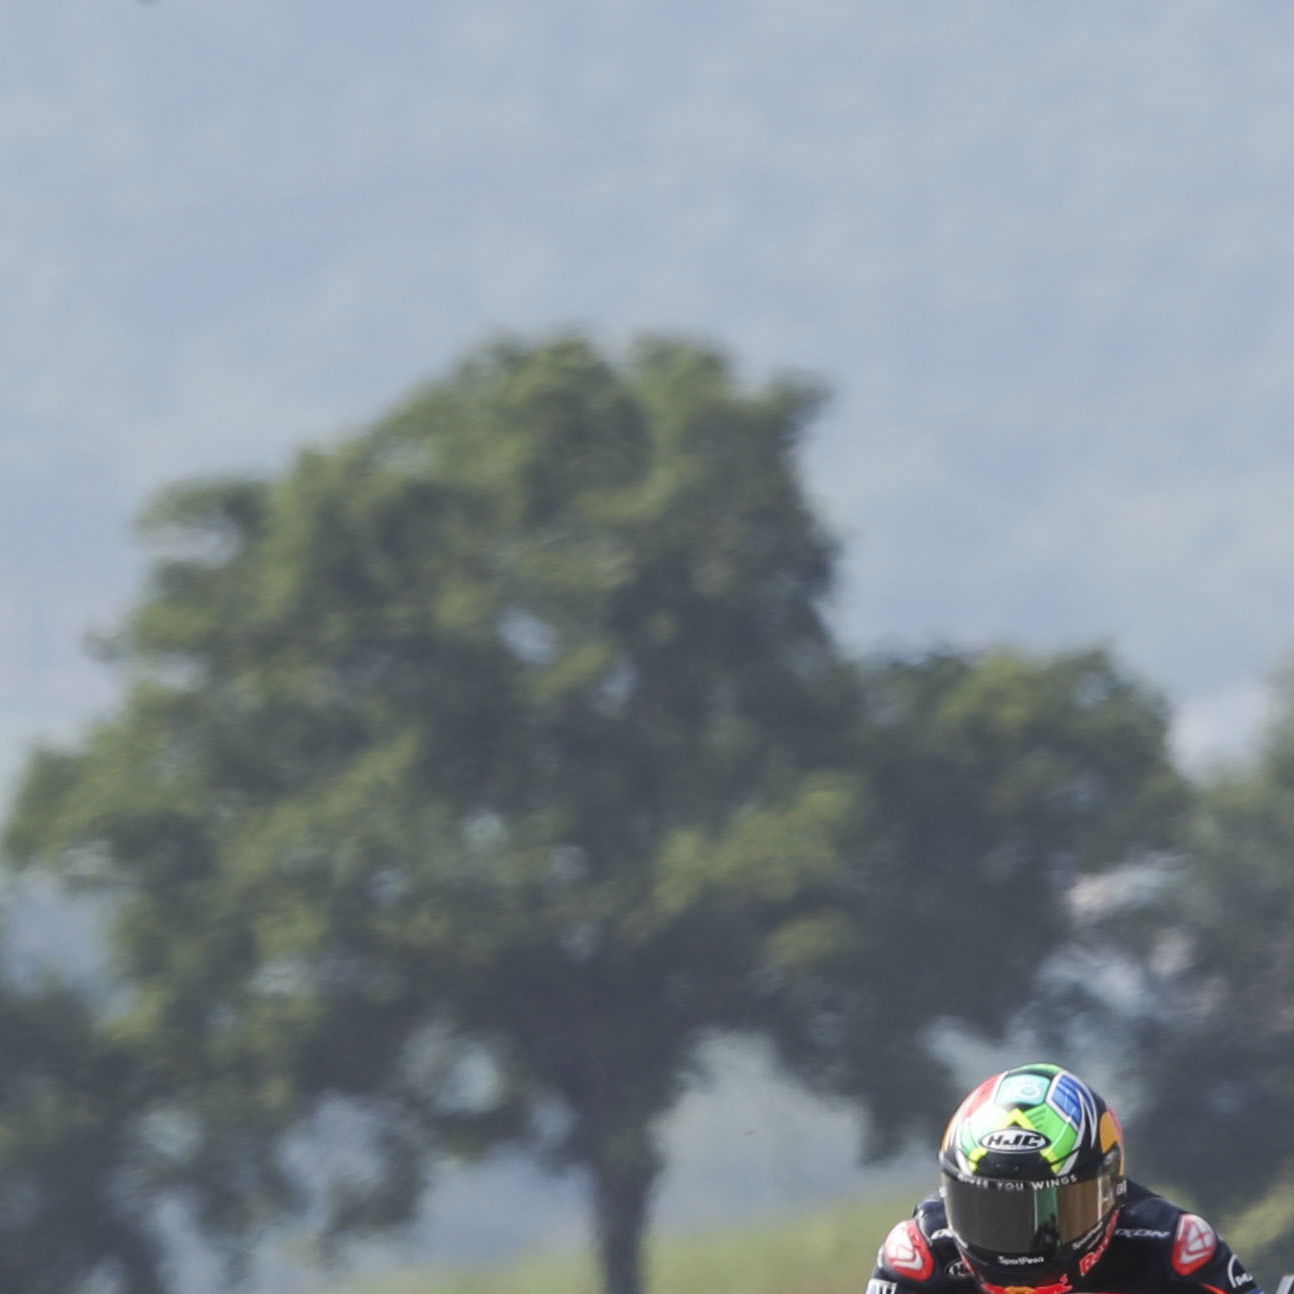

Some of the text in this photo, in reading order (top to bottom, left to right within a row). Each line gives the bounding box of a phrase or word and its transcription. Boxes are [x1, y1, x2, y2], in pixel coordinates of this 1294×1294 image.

[987, 1134, 1042, 1147] HJC
[997, 1182, 1024, 1191] YOU
[1031, 1174, 1077, 1191] WINGS
